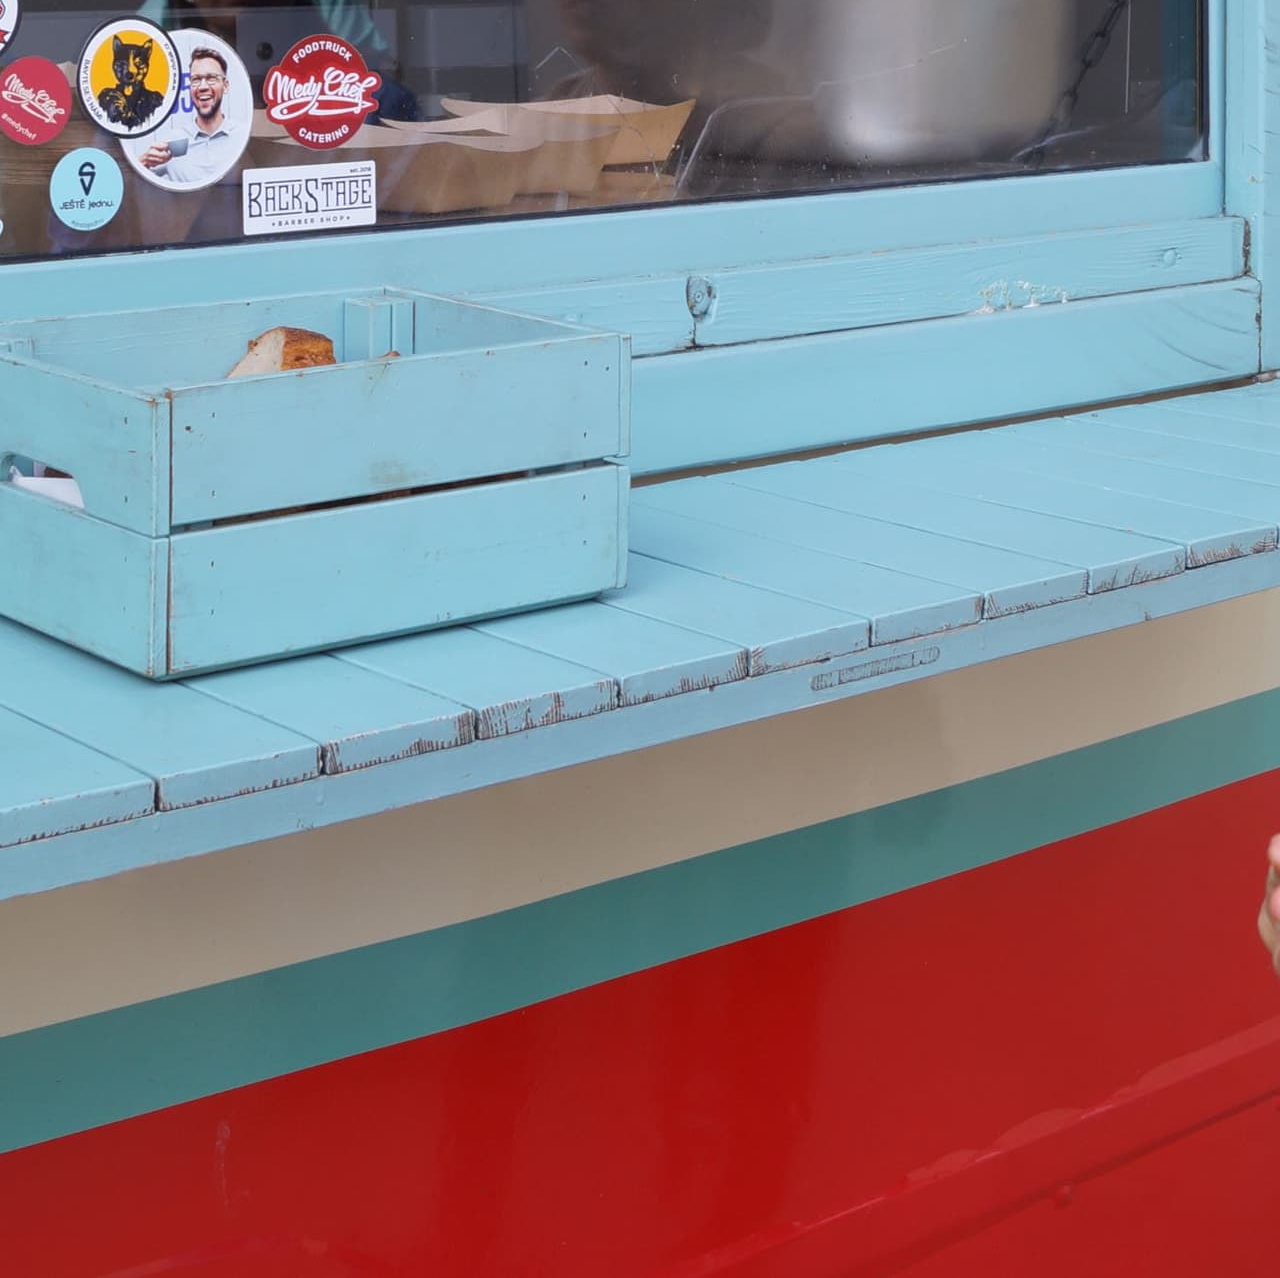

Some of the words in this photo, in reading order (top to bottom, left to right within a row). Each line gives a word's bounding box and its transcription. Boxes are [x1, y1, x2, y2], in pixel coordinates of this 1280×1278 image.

[292, 40, 353, 64] FOODTRUCK
[267, 70, 323, 120] Medy
[322, 65, 378, 115] Chef
[298, 124, 351, 143] CATERING
